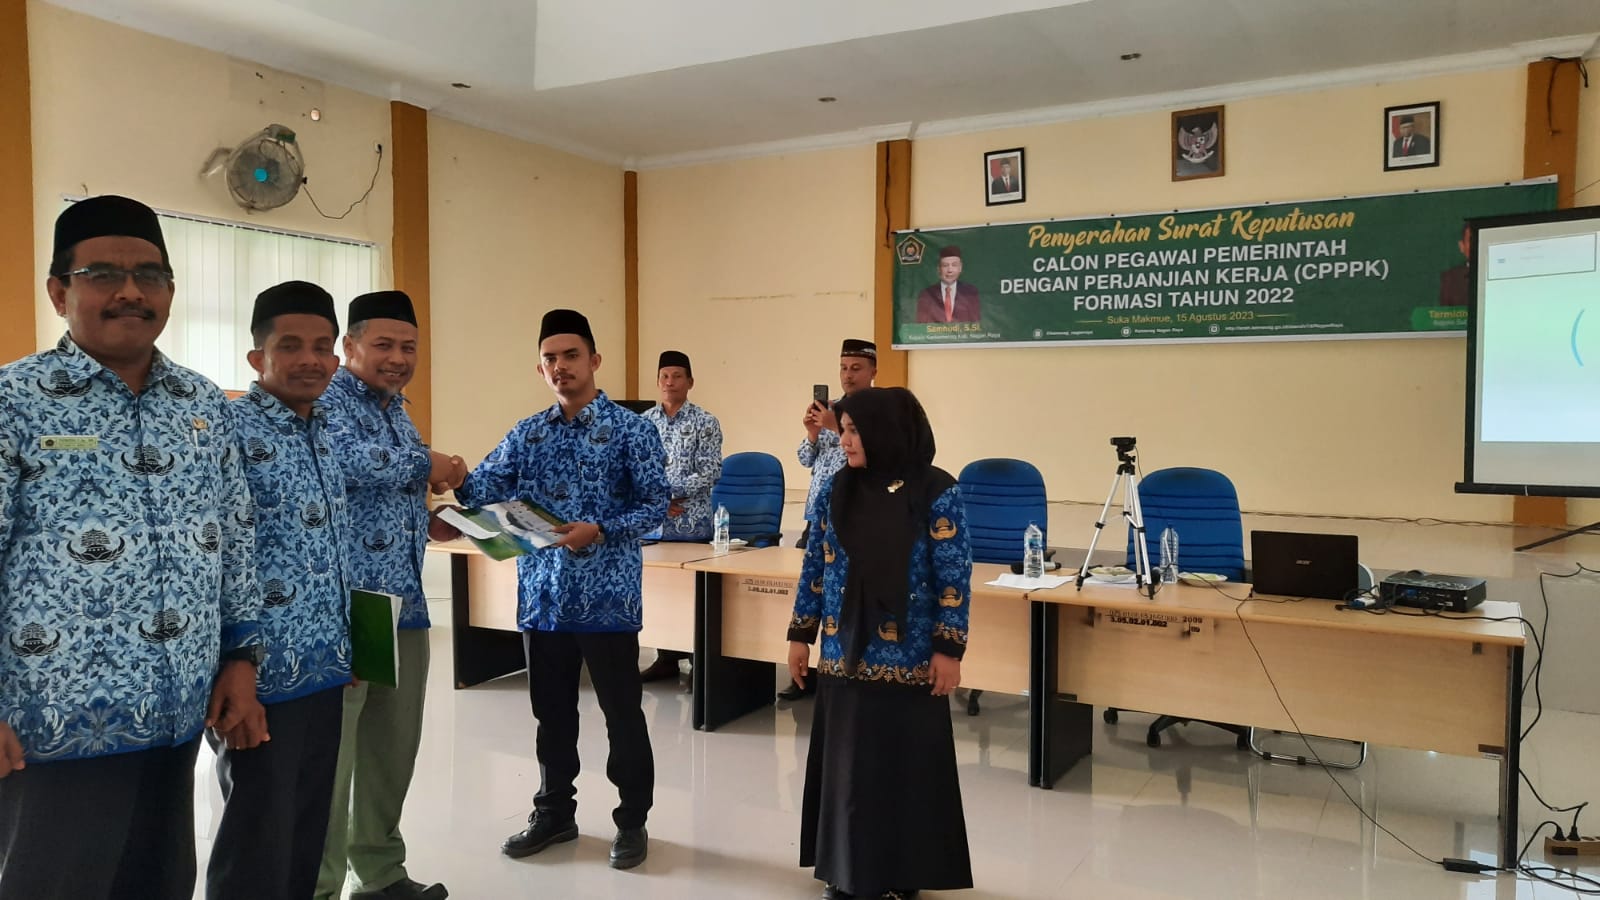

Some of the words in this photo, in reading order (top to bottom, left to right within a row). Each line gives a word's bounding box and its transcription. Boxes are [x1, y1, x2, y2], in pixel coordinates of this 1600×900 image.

[1028, 220, 1151, 254] Penyerahan
[1158, 213, 1227, 241] Surat
[1230, 208, 1355, 242] Keputusan
[1033, 255, 1099, 273] CALON
[1104, 249, 1197, 269] PEGAWAI
[1203, 239, 1347, 264] PEMERINTAH
[1000, 276, 1078, 294] DENGAN
[1084, 269, 1209, 290] PERJANJIAN
[1215, 265, 1289, 284] KERJA
[1294, 259, 1389, 284] (CPPPK)
[1073, 292, 1162, 311] FORMASI
[1168, 289, 1239, 307] TAHUN
[1245, 287, 1294, 304] 2022
[1107, 315, 1129, 325] Suka
[1132, 313, 1173, 324] Makmue,
[1176, 312, 1188, 322] 15
[1188, 312, 1227, 323] Agustus
[1229, 310, 1254, 321] 2023
